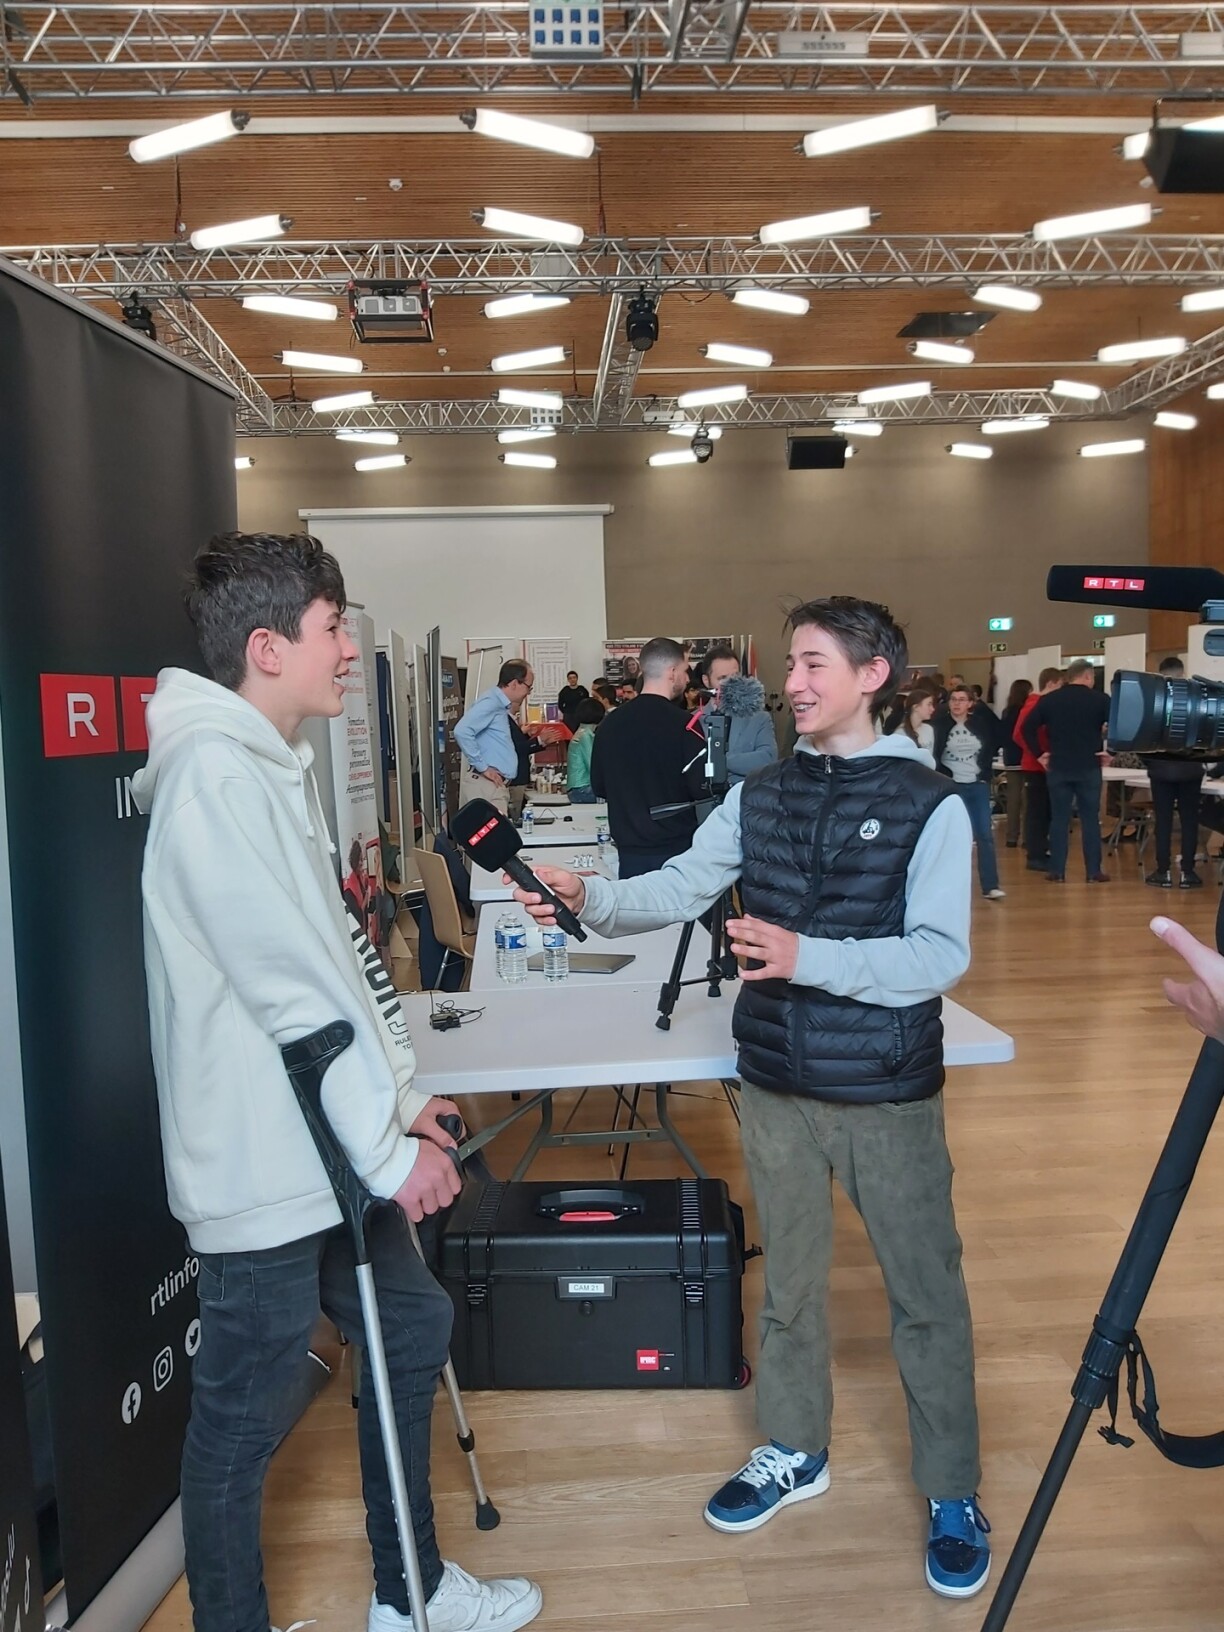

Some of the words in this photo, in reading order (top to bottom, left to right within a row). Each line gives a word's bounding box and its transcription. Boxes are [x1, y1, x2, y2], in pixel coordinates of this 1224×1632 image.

[1087, 579, 1140, 589] RTL
[470, 818, 498, 844] RTL
[150, 1256, 200, 1316] rtlinfo
[591, 1284, 599, 1292] 21
